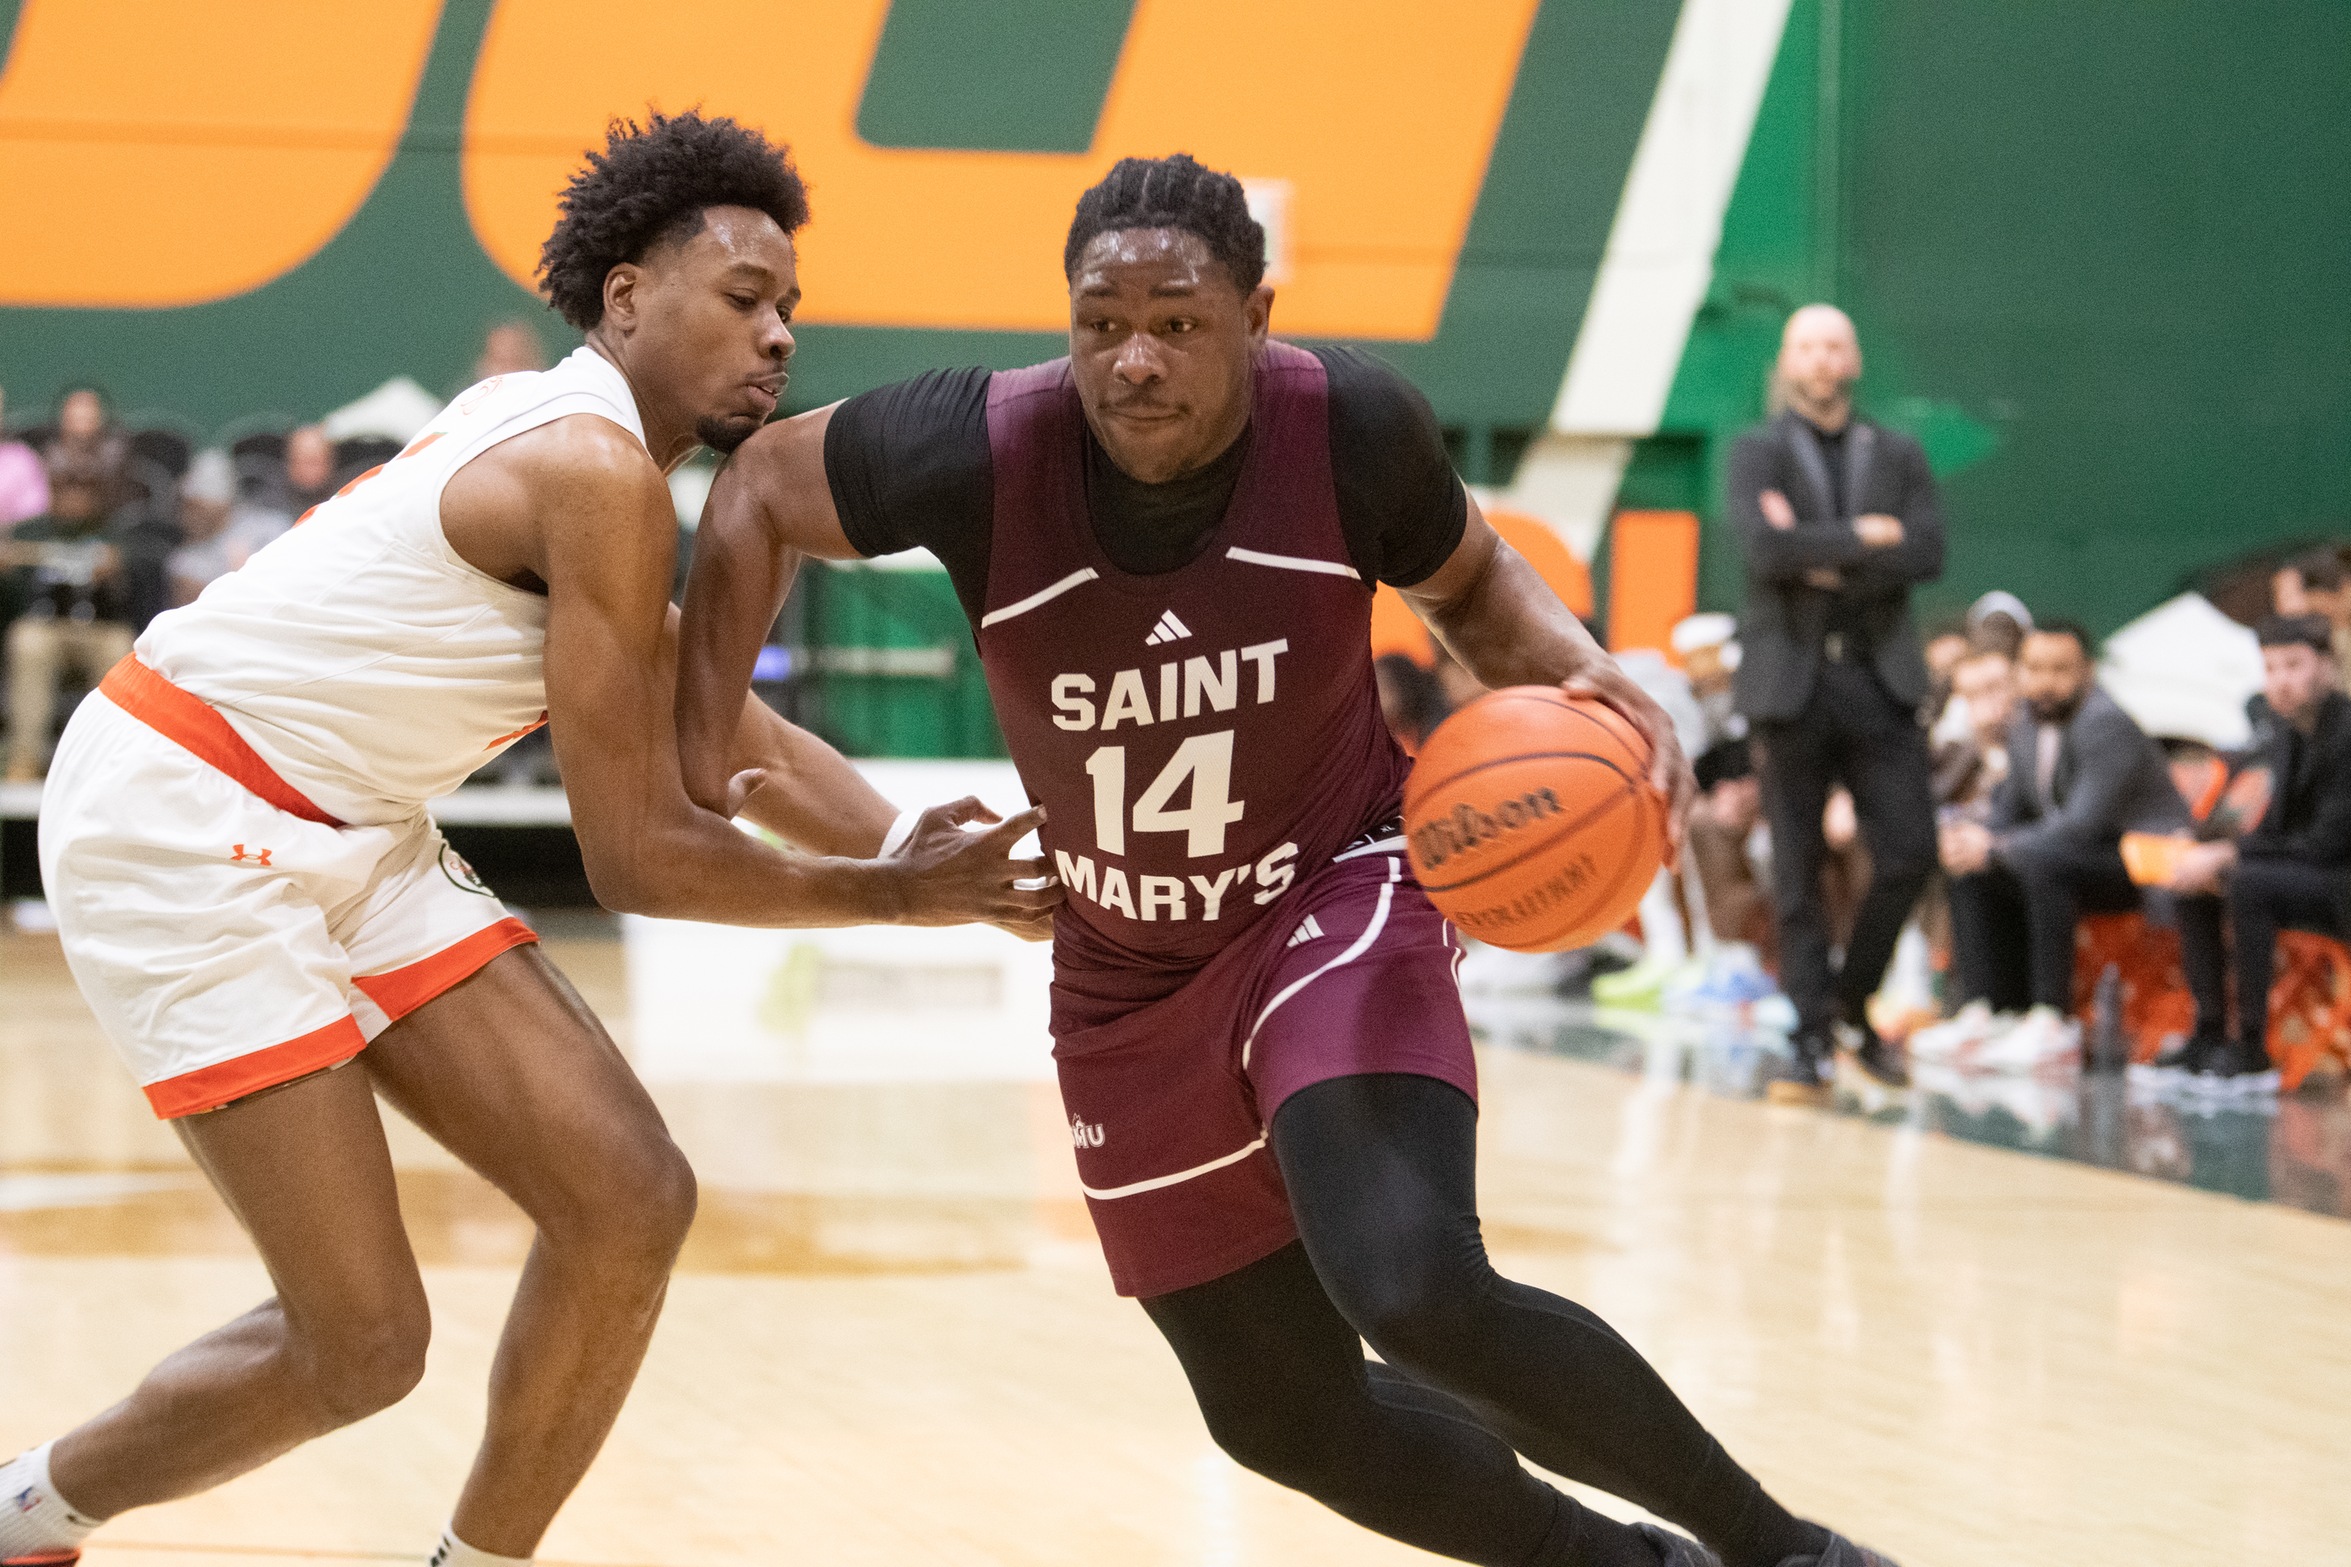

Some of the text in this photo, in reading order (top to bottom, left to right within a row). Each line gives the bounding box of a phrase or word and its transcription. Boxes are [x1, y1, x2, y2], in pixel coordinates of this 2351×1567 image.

[1051, 638, 1289, 731] SAINT
[1085, 729, 1245, 858] 14
[1414, 787, 1563, 871] Wilson
[1055, 841, 1298, 921] MARY'S
[1071, 1123, 1106, 1149] MU
